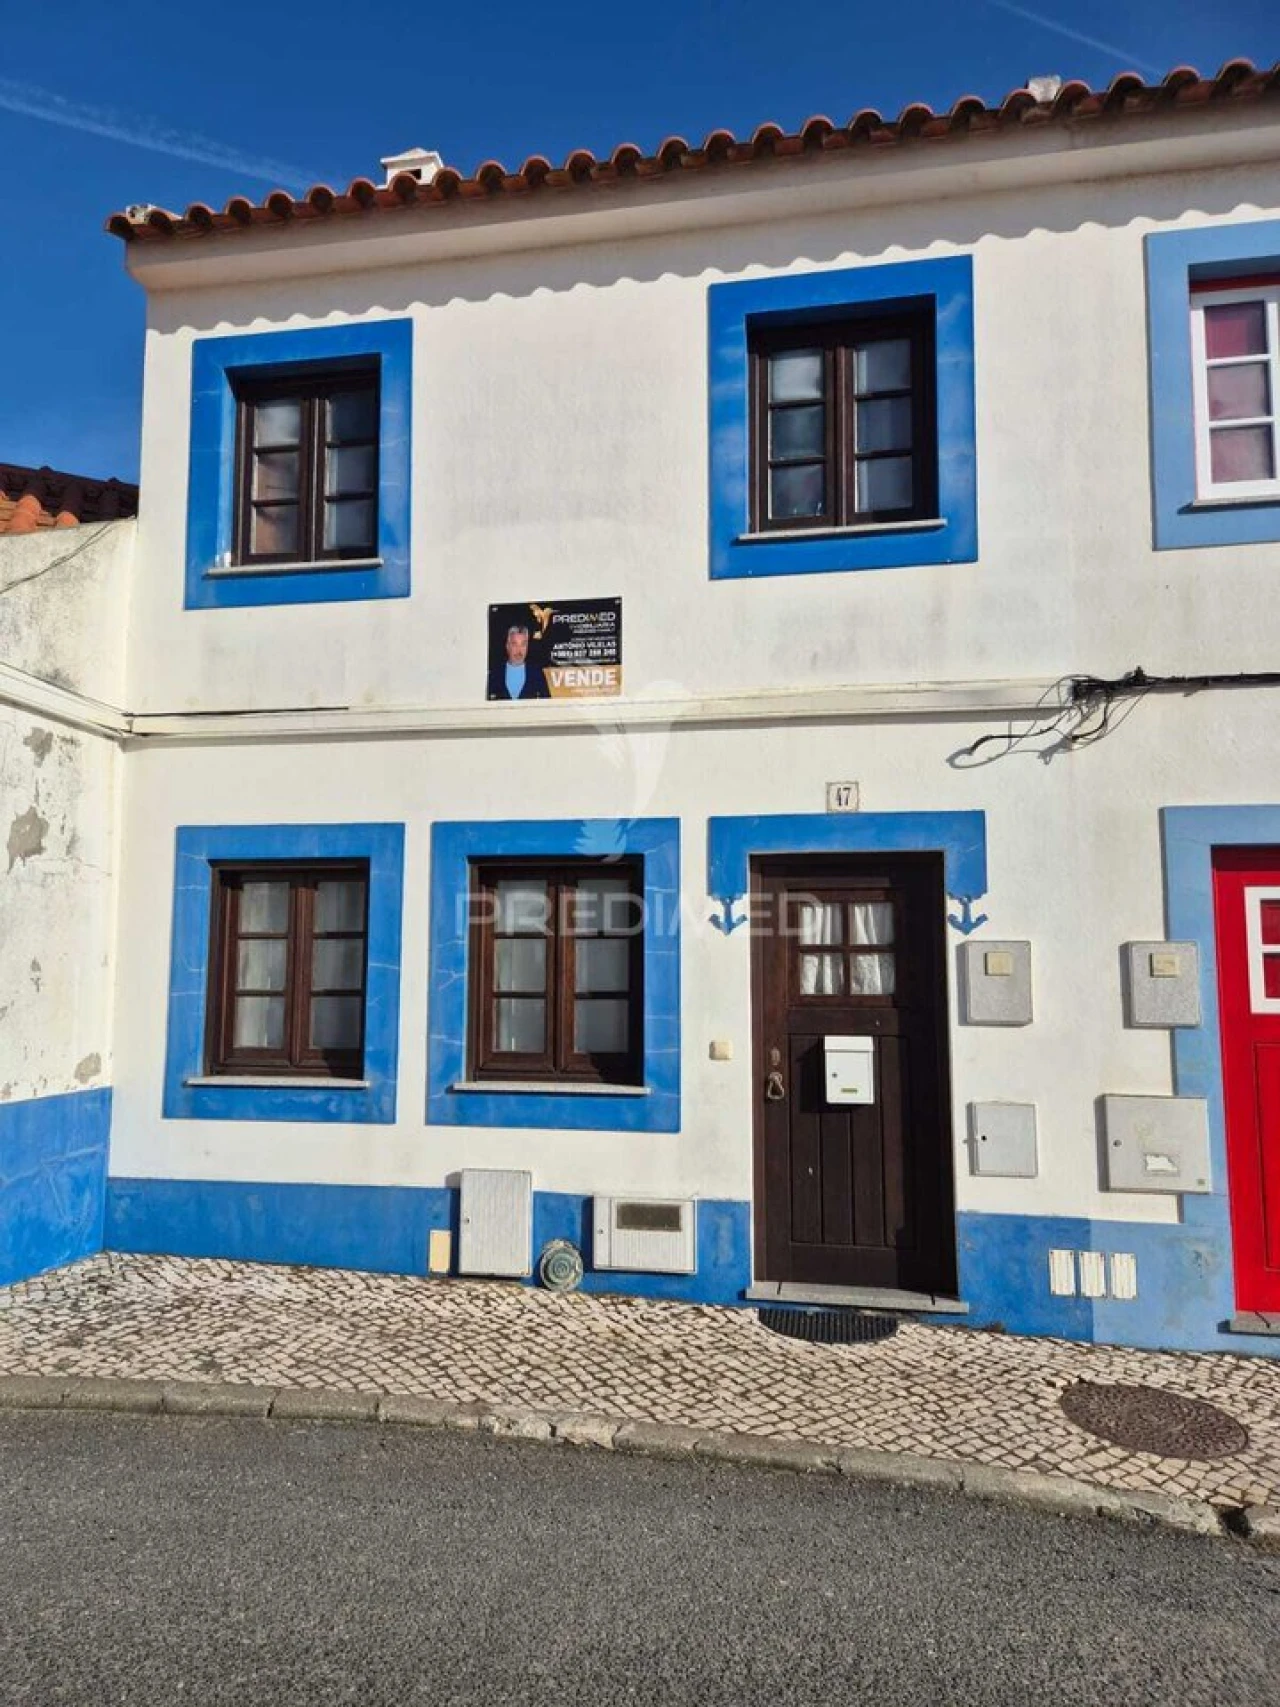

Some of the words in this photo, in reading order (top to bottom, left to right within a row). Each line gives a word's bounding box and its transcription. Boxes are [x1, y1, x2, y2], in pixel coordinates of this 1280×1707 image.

[552, 611, 616, 624] PREDIMED
[550, 667, 618, 688] VENDE
[836, 787, 852, 806] 47
